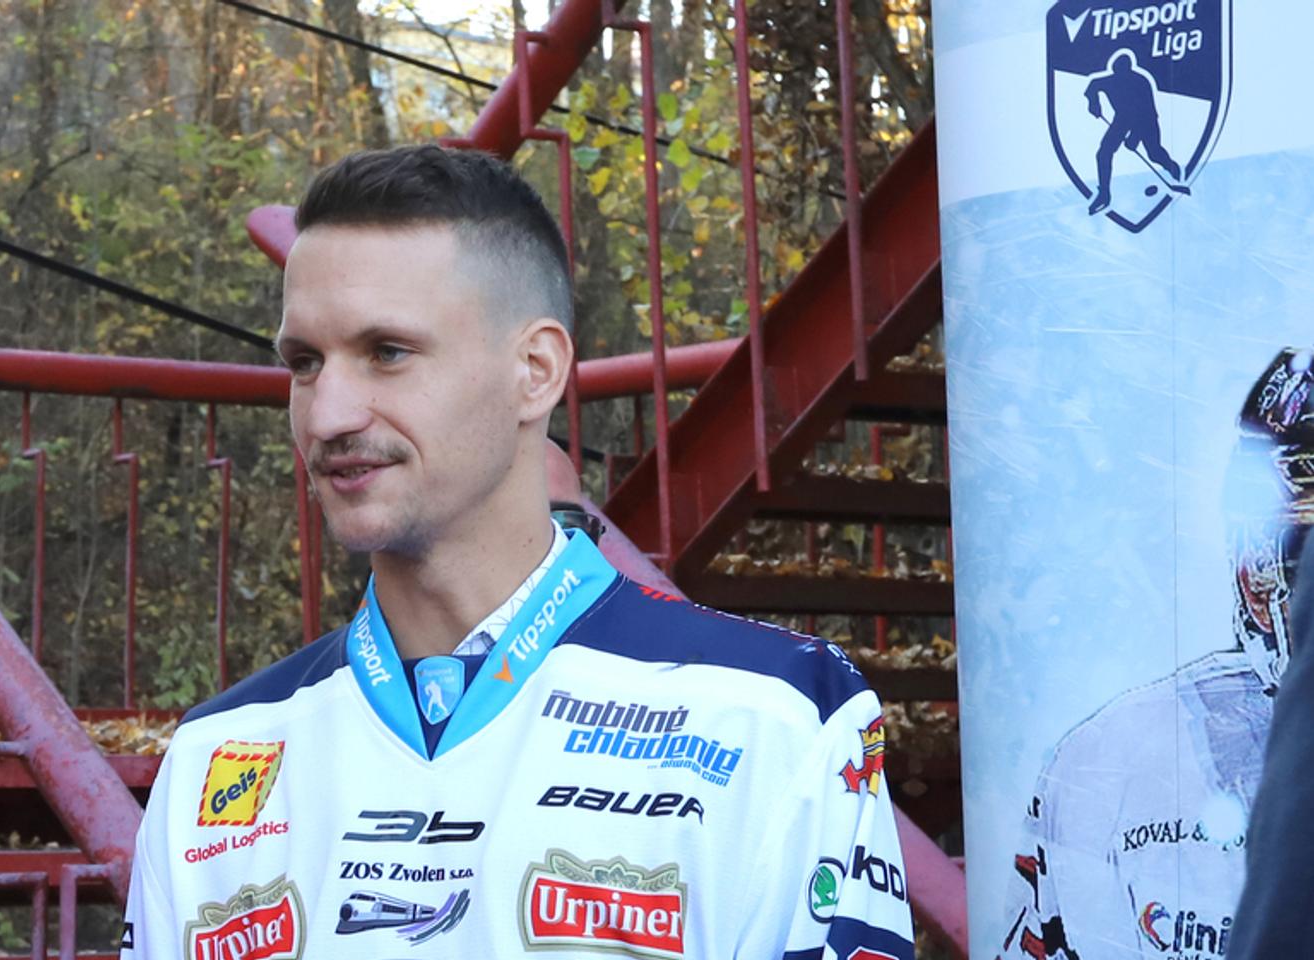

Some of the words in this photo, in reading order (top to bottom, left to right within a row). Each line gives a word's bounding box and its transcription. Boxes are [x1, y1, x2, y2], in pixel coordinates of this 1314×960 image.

[1091, 0, 1196, 39] Tipsport
[1151, 29, 1203, 60] Liga
[508, 568, 581, 660] Tipsport
[354, 608, 393, 686] Tipsport
[541, 694, 690, 734] mobilné
[210, 767, 258, 815] Geis
[184, 838, 227, 864] Global
[1123, 819, 1188, 852] KOVAL
[339, 861, 384, 880] ZOS
[388, 863, 445, 882] Zvolen
[851, 845, 906, 902] KOD
[538, 884, 683, 938] Urpiner
[1138, 901, 1233, 956] Clini
